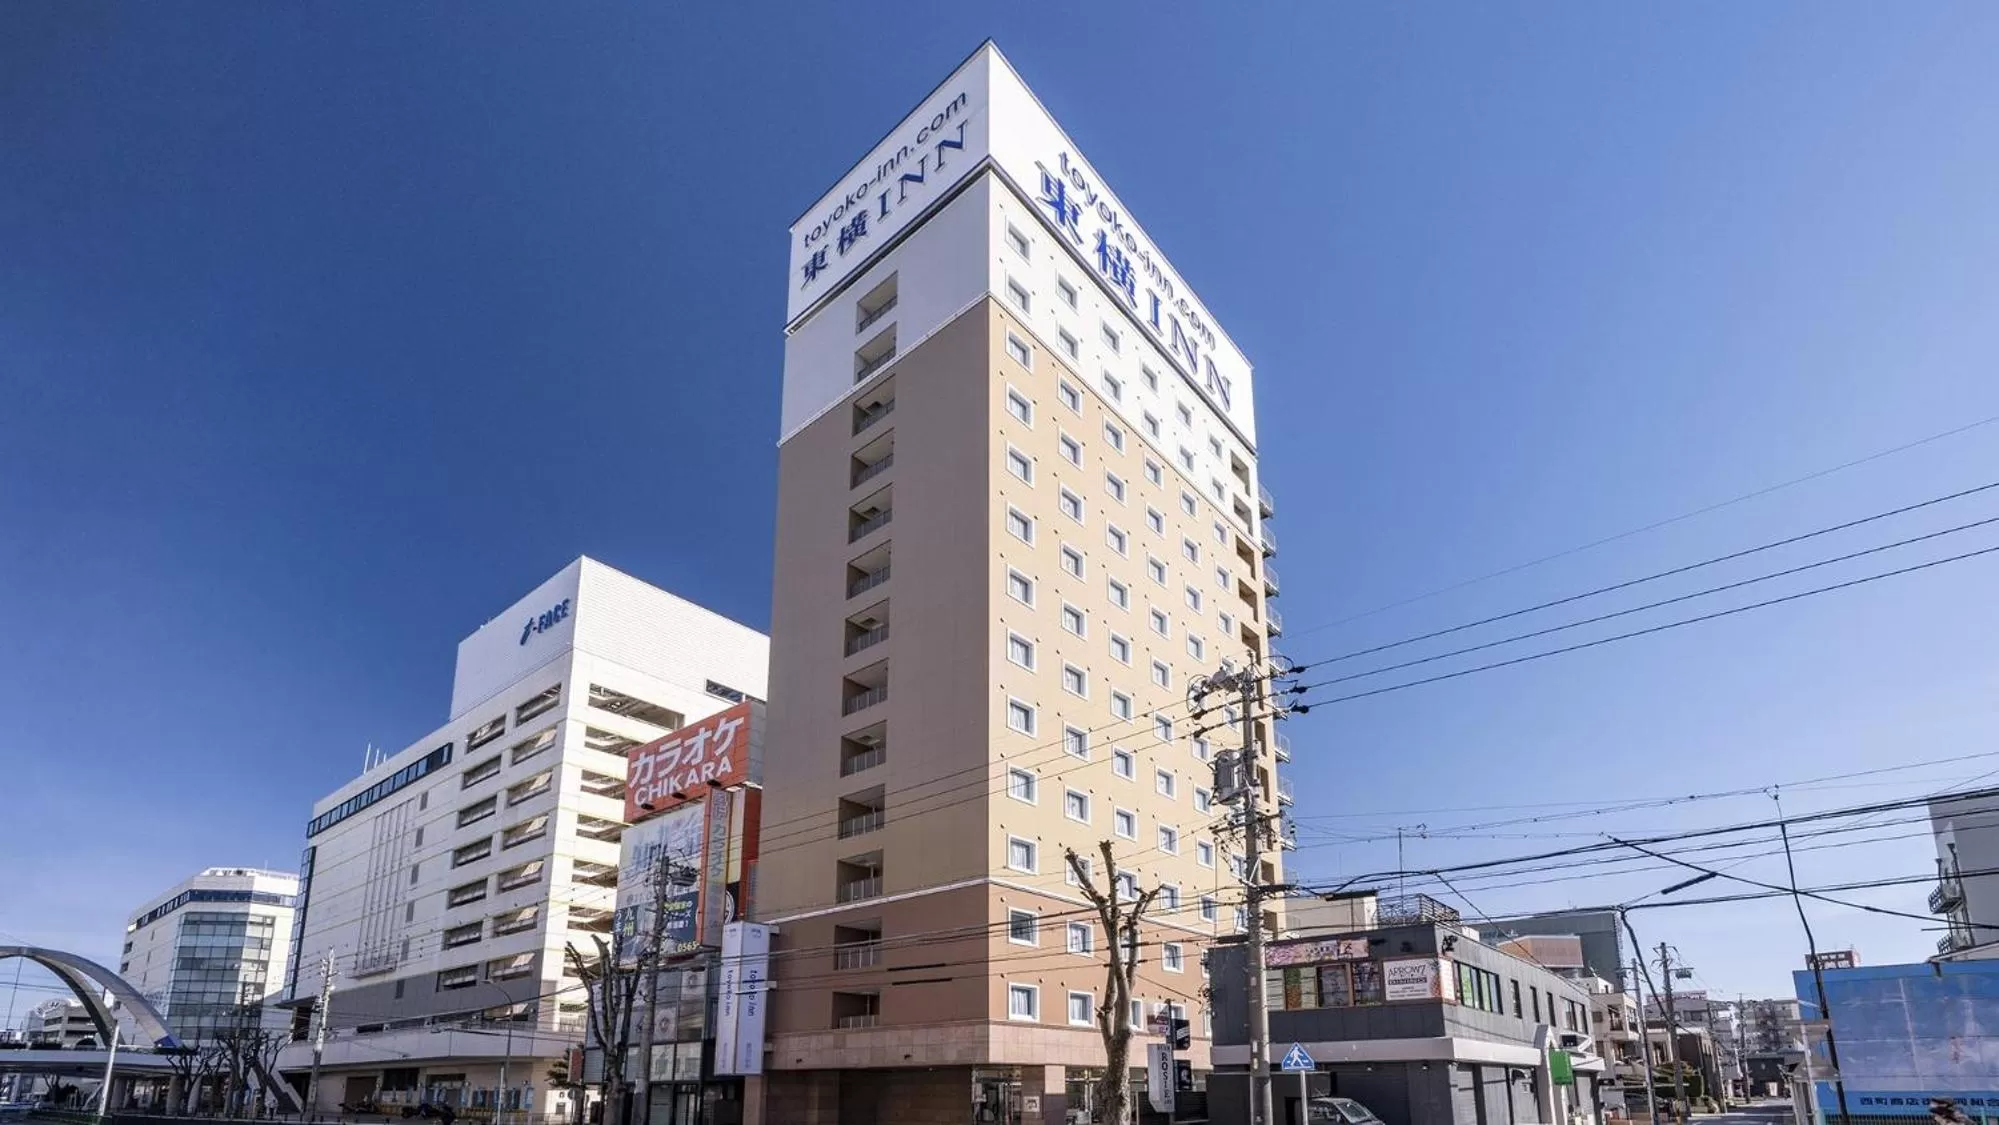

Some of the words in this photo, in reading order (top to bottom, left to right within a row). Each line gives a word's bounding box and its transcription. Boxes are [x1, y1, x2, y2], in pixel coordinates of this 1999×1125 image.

[804, 91, 967, 248] toyoko-inn.com
[1058, 151, 1216, 351] toyoko-inn.com
[628, 716, 744, 788] カラオケ
[634, 757, 733, 806] CHIKARA
[1161, 1052, 1170, 1098] ROSIE
